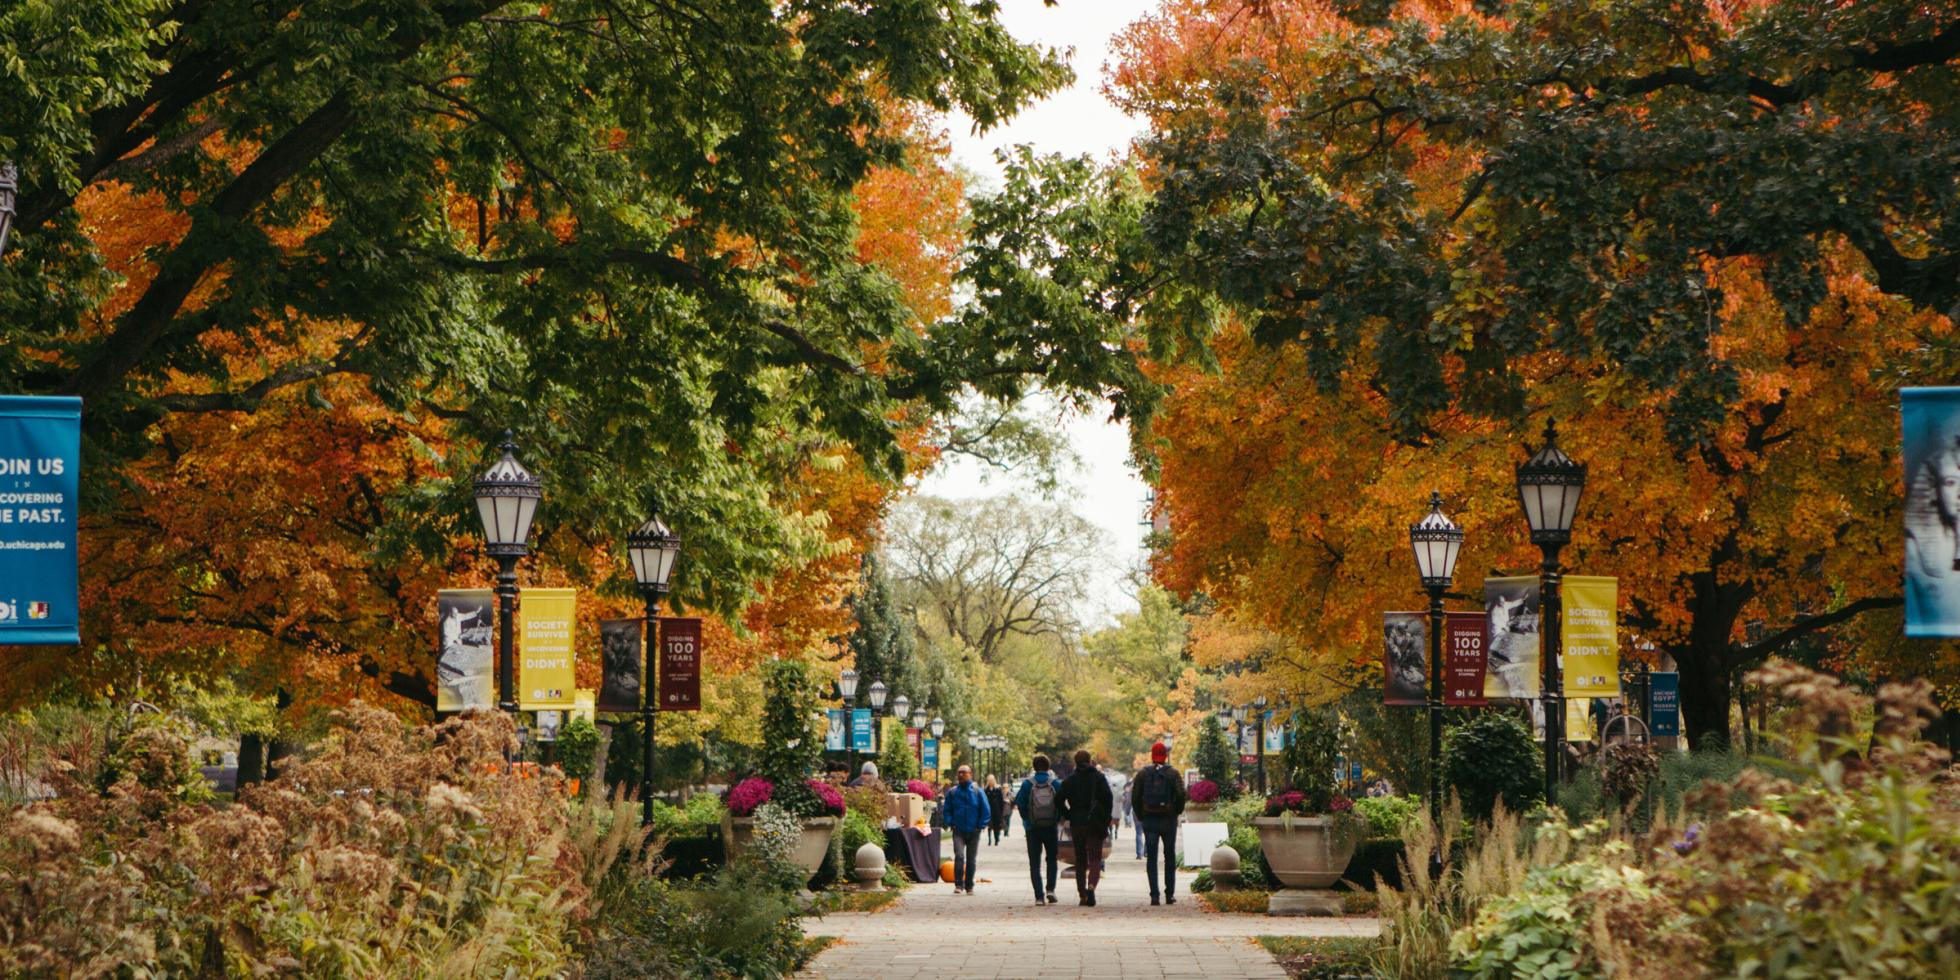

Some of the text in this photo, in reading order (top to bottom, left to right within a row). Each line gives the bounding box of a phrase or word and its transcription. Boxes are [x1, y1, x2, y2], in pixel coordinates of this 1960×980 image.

[38, 458, 64, 475] US
[0, 509, 65, 523] E PAST.
[1568, 608, 1610, 617] SOCIETY
[527, 621, 569, 629] SOCIETY
[667, 642, 694, 654] 100
[1454, 637, 1481, 649] 100
[1568, 646, 1612, 656] DIDN'T.
[526, 659, 569, 669] DIDN'T.
